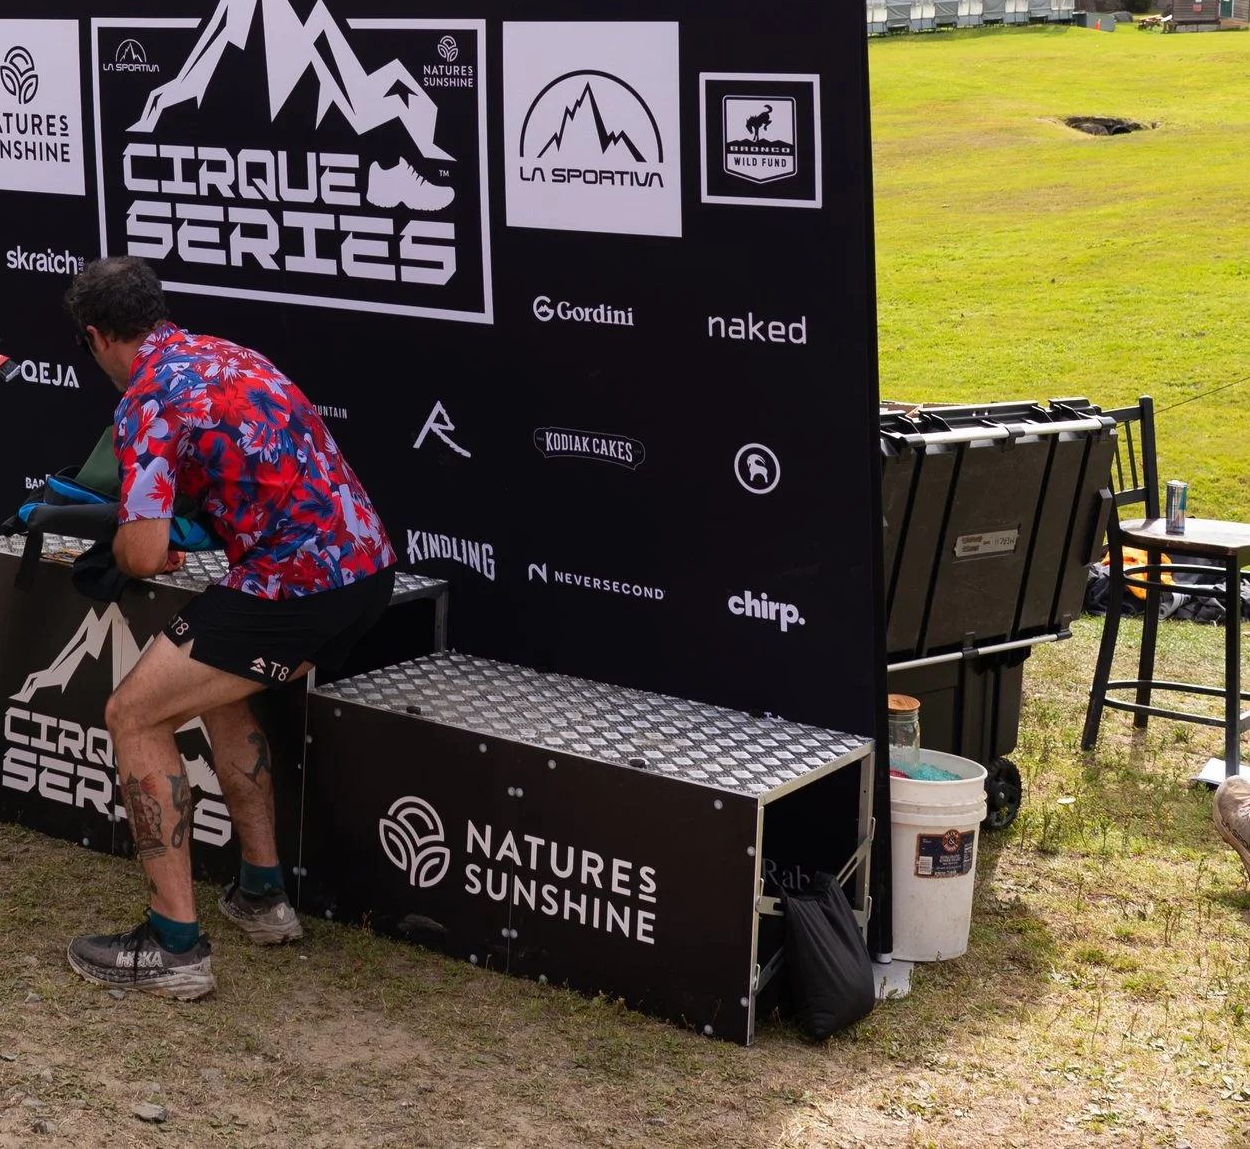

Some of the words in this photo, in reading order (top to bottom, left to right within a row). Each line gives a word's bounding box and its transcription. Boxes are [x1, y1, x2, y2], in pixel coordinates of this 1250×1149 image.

[103, 63, 114, 72] LA
[116, 63, 160, 72] SPORTIVA
[423, 65, 474, 78] NATURES
[423, 76, 474, 88] SUNSHINE
[729, 145, 791, 153] BRONCO
[733, 156, 758, 168] WILD
[761, 157, 787, 168] FUND
[123, 143, 361, 206] CIRQUE
[519, 166, 546, 183] LA
[551, 168, 664, 188] SPORTIVA
[125, 200, 456, 286] SERIES
[6, 245, 78, 275] skratch
[557, 302, 634, 327] Gordini
[708, 312, 807, 344] naked
[545, 432, 590, 453] KODIAK
[592, 438, 633, 462] CAKES
[406, 528, 495, 581] KINDLING
[555, 570, 664, 600] NEVERSECOND
[171, 616, 189, 636] T8
[728, 590, 806, 632] chirp.
[270, 661, 290, 682] T8
[4, 707, 116, 768] CIRQ
[2, 747, 232, 847] SERS
[467, 819, 657, 904] NATURES
[762, 858, 811, 891] Rab
[464, 863, 656, 946] SUNSHINE
[116, 951, 164, 968] HOKA
